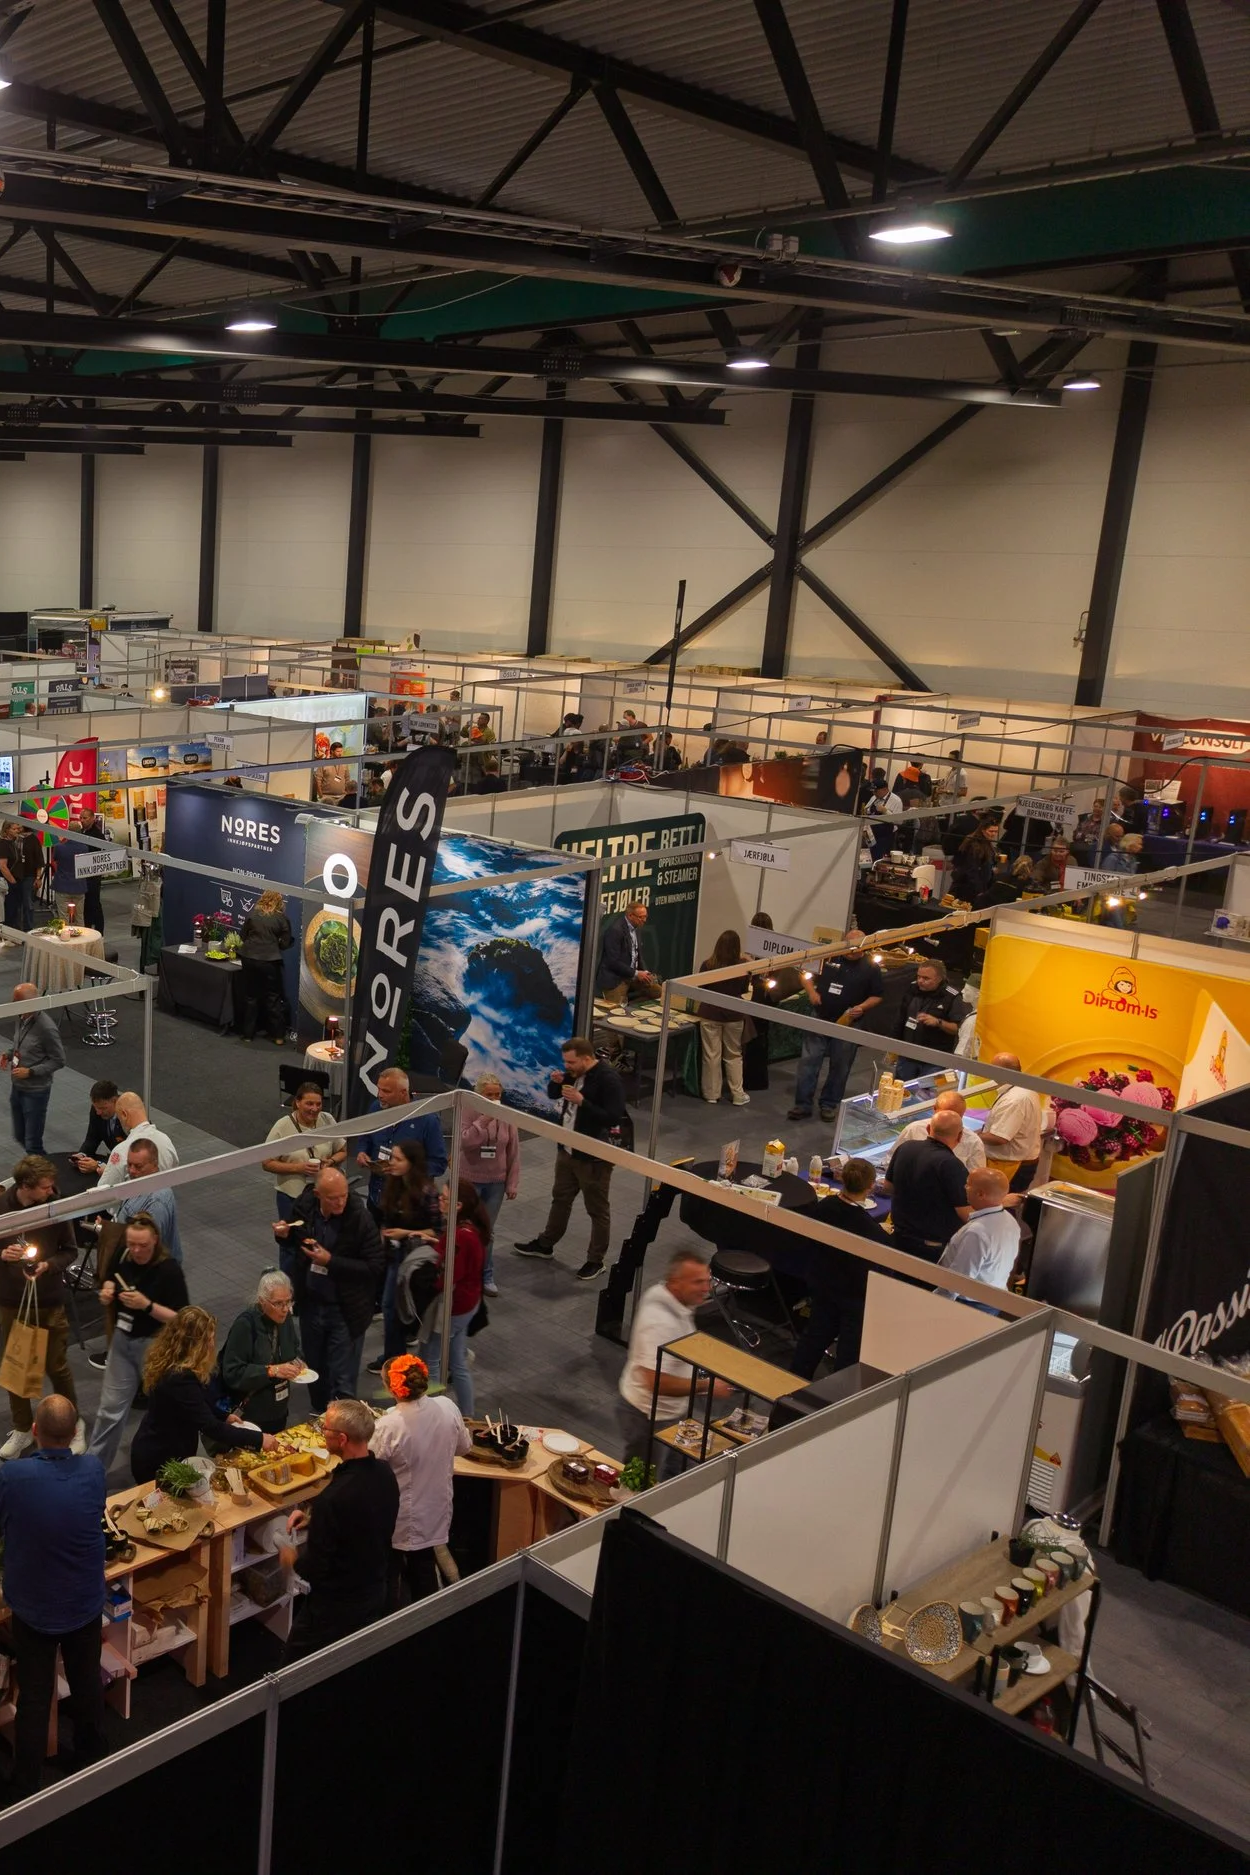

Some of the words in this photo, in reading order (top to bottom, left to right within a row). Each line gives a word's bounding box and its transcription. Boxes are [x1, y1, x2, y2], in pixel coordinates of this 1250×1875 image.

[1018, 800, 1054, 812] KJELDSBERG
[1057, 814, 1065, 822] AS
[221, 815, 280, 844] NORES
[92, 853, 111, 864] NORES
[744, 850, 775, 863] JÆRFJØLA
[77, 860, 127, 877] INNKJØPSPARTNER
[232, 867, 265, 879] NON-PROFIT
[664, 867, 698, 885] STEAMER
[359, 786, 437, 1098] NORES
